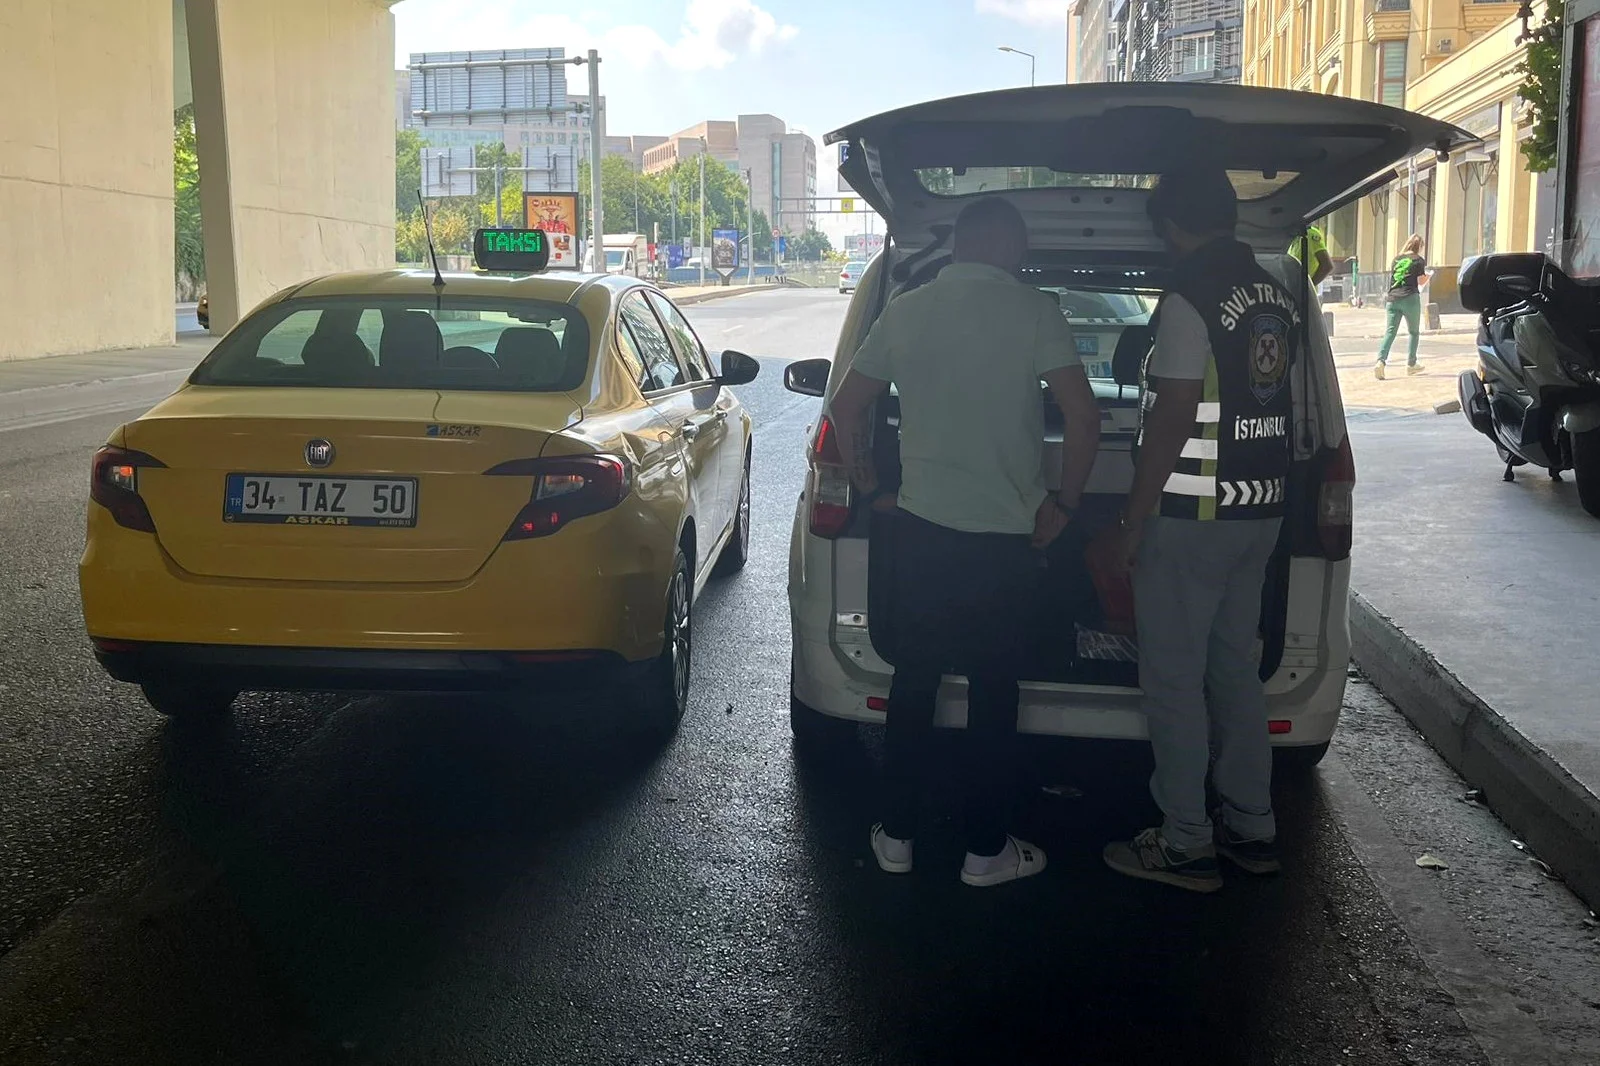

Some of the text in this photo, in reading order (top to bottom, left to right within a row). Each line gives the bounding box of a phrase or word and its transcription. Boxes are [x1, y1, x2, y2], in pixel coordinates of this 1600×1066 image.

[1220, 286, 1256, 331] SİVİL
[310, 445, 329, 460] FIAT
[231, 497, 242, 507] TR
[245, 480, 406, 514] 34 TAZ 50
[284, 515, 349, 526] ASKAR
